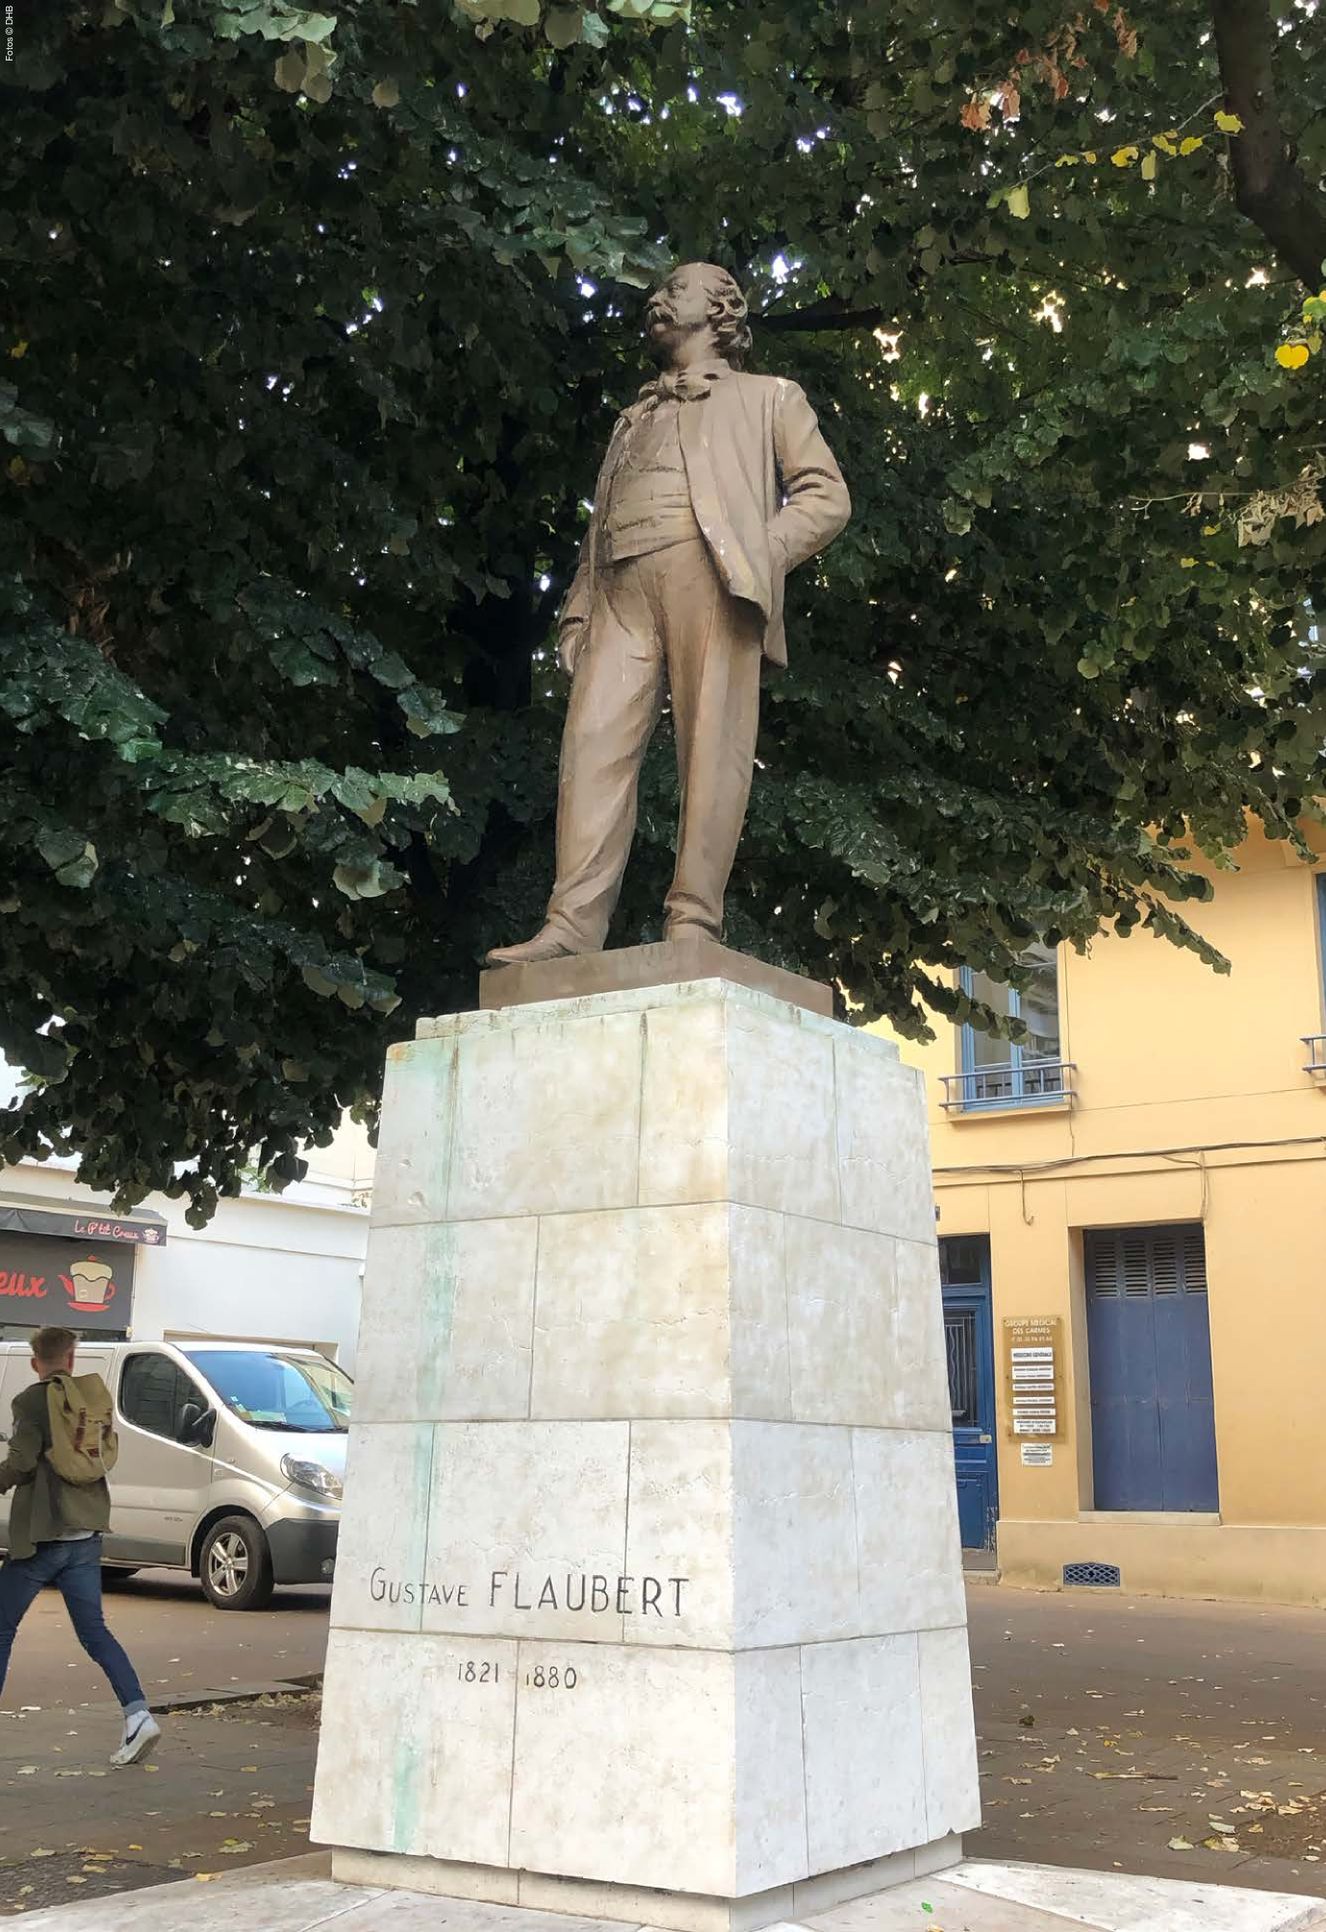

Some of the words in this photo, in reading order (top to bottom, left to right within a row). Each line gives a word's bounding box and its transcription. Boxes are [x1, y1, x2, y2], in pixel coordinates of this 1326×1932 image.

[74, 1219, 86, 1233] Le
[489, 1571, 690, 1617] FLAUBERT
[457, 1661, 500, 1683] 1821
[526, 1665, 577, 1689] 1880
